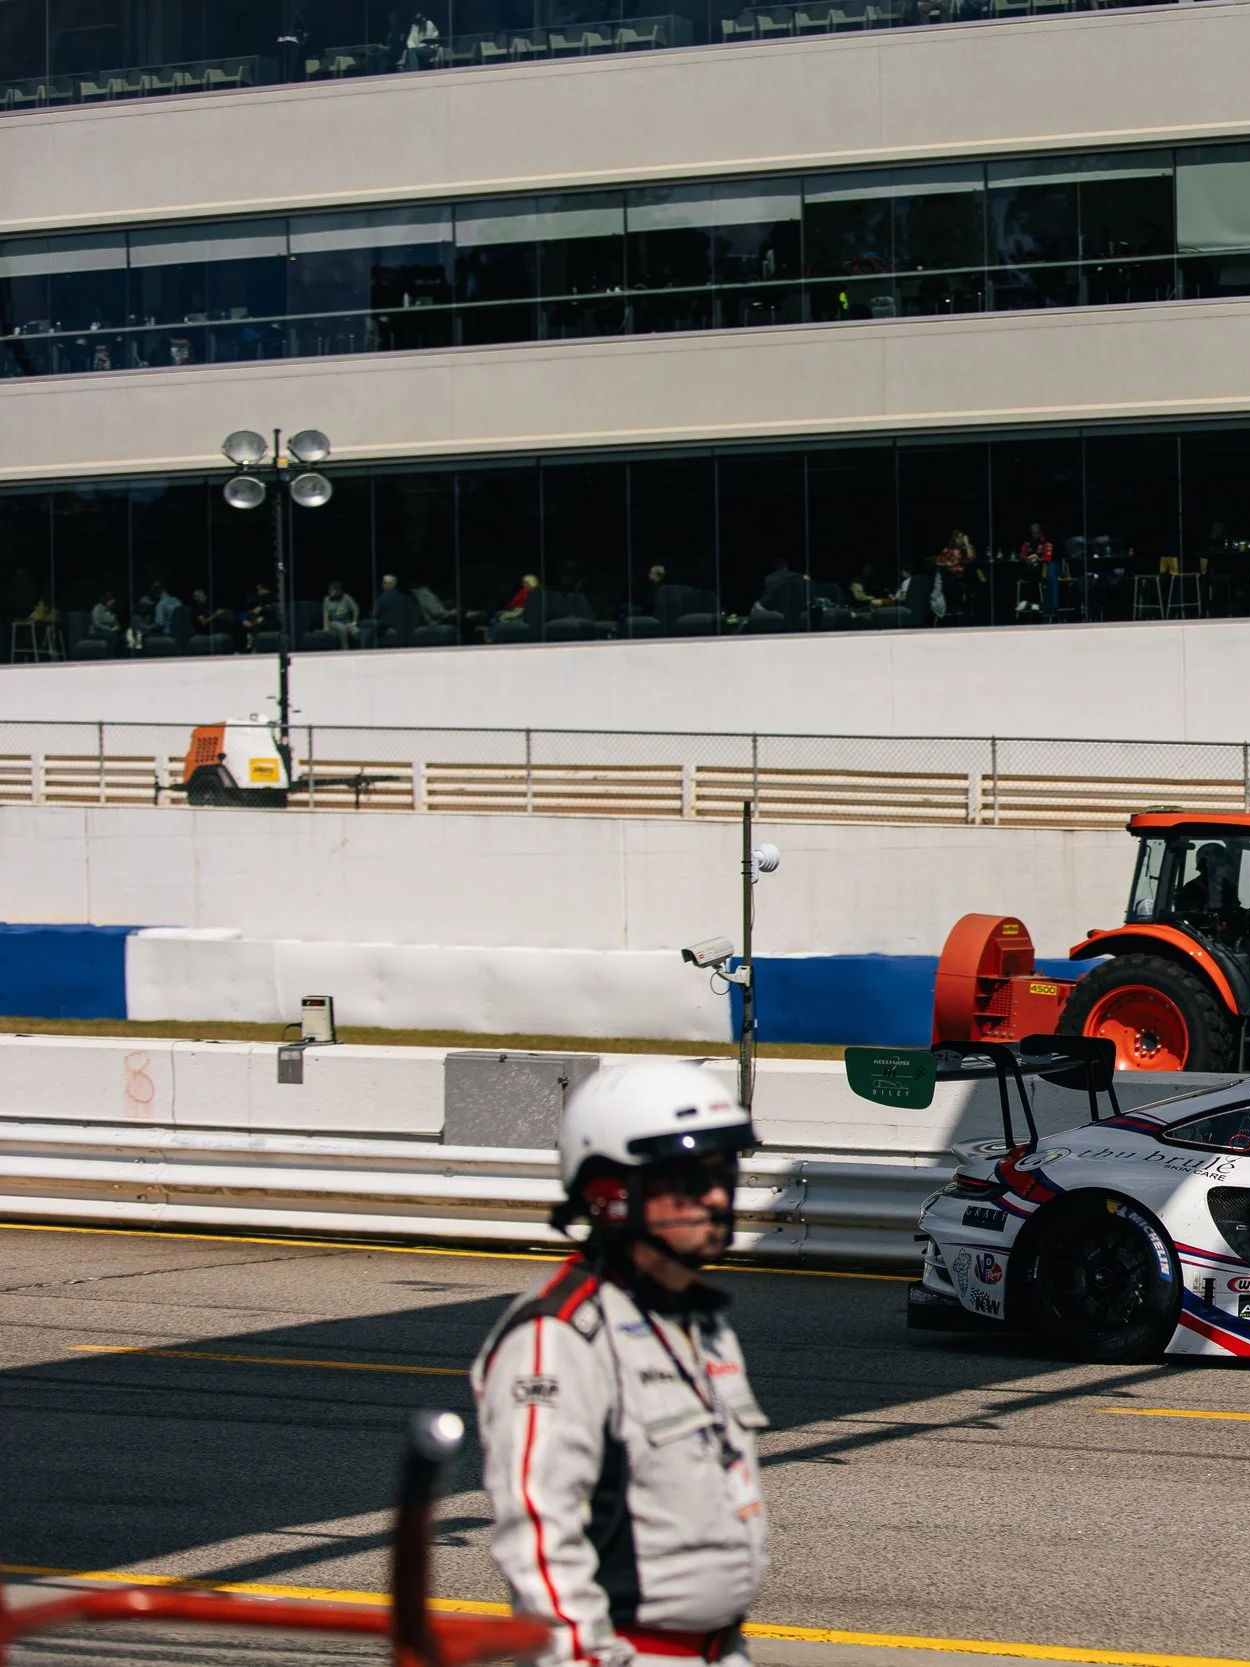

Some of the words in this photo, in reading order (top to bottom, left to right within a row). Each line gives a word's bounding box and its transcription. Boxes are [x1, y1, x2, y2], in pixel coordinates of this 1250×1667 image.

[1030, 984, 1056, 995] 4500
[1162, 1164, 1191, 1173] SKIN
[1193, 1169, 1227, 1182] CARE
[966, 1206, 1009, 1222] GRAFF
